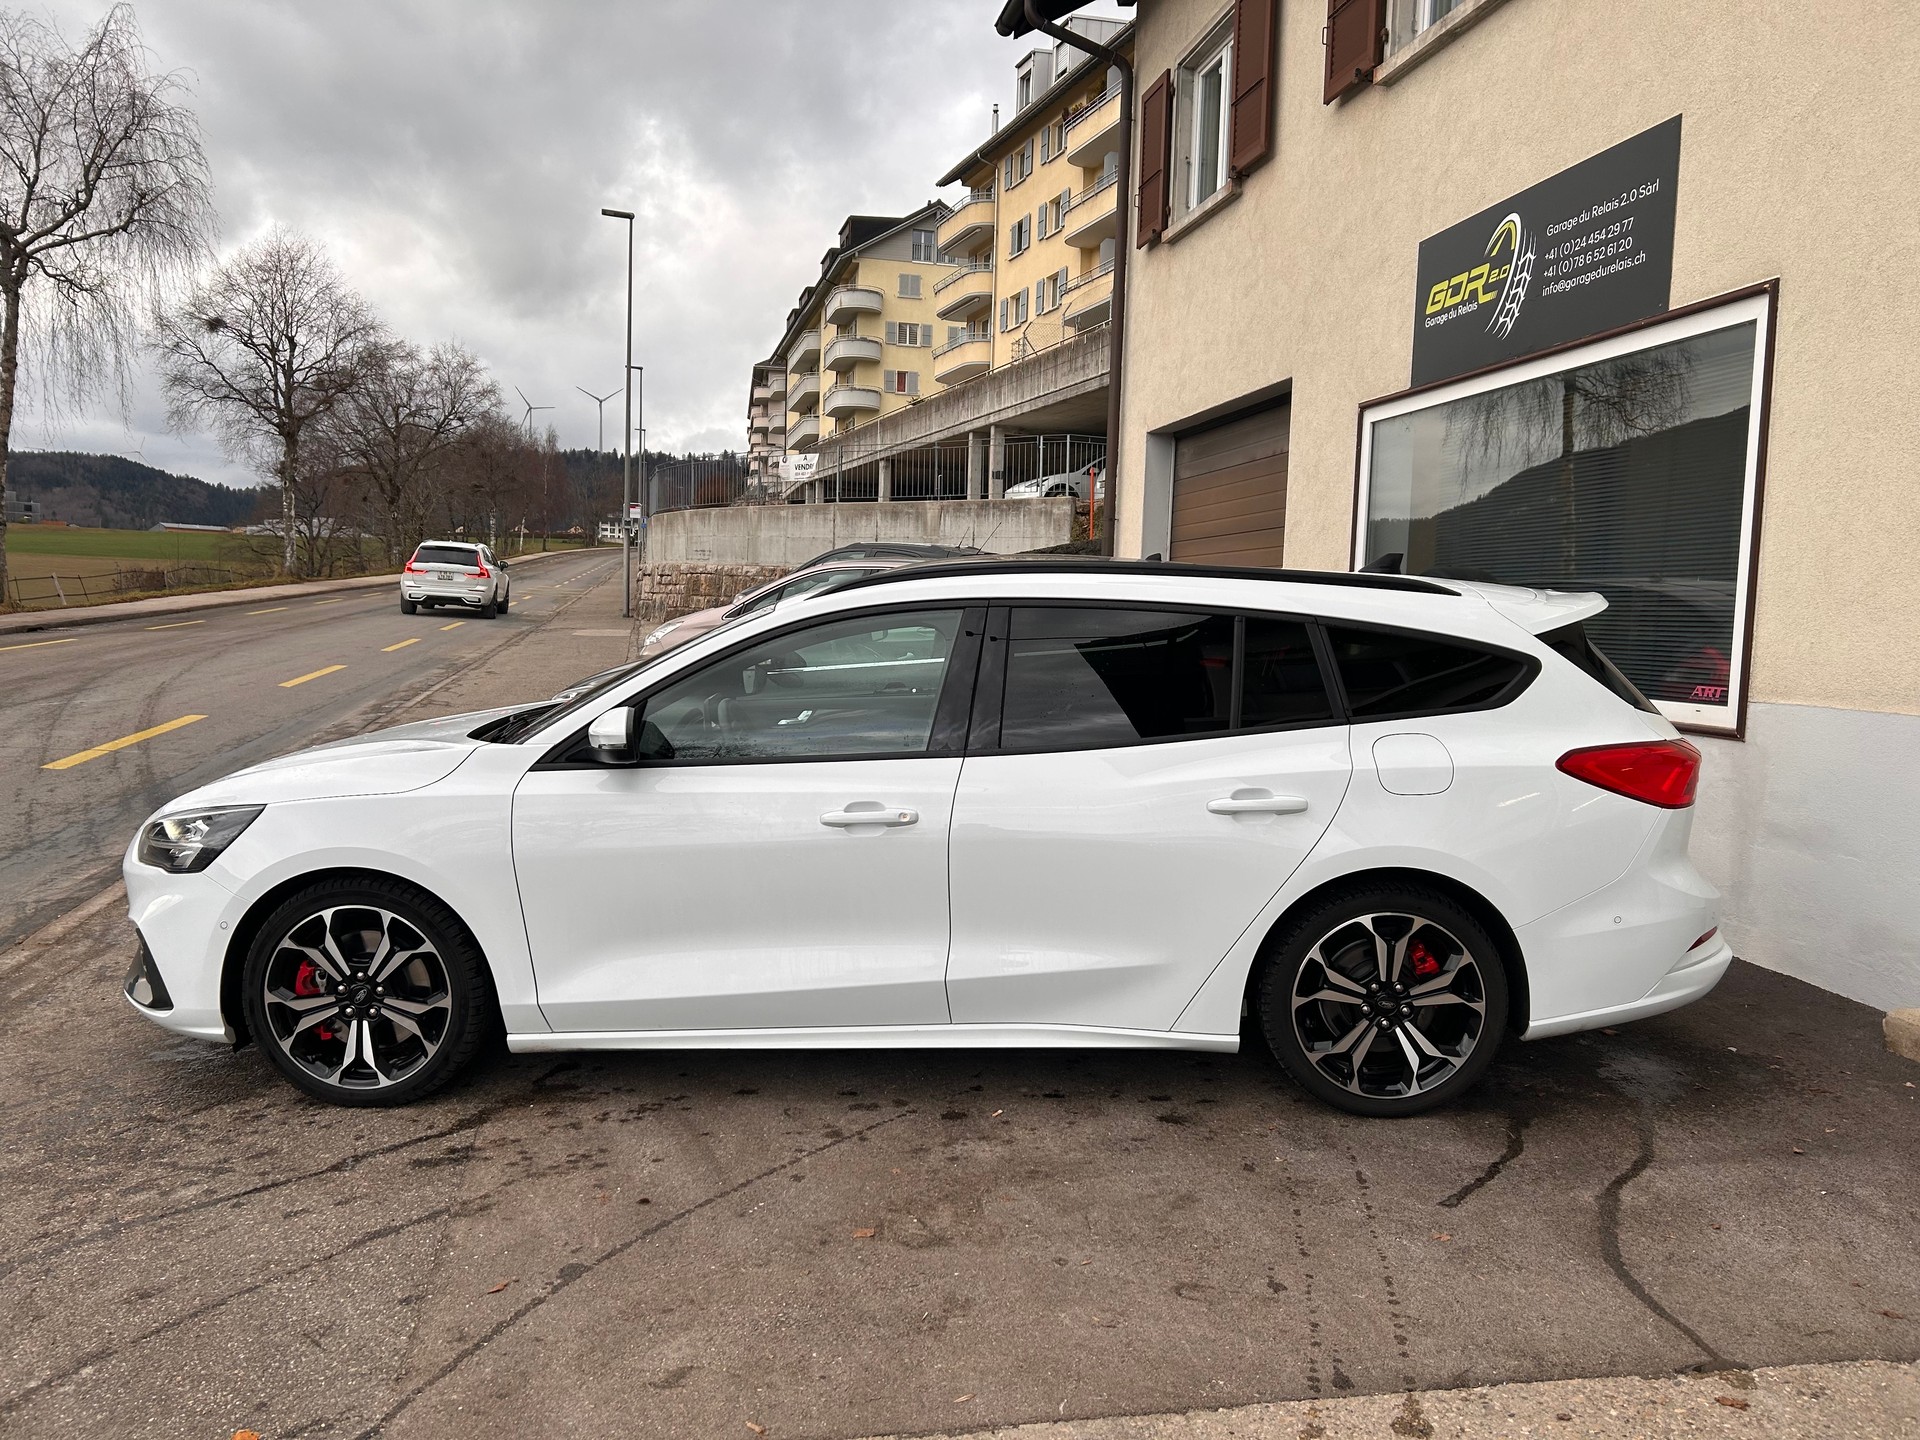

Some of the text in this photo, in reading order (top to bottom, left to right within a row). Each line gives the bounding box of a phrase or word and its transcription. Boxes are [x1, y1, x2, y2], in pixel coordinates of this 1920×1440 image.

[1546, 178, 1660, 237] Garage du Relais 2.0 Sàrl
[1543, 264, 1557, 278] +41
[1593, 246, 1606, 262] 52
[1607, 241, 1618, 256] 61
[1618, 236, 1633, 253] 20
[1544, 246, 1558, 260] +41
[1588, 228, 1606, 245] 454
[1607, 222, 1620, 238] 29
[1622, 216, 1634, 232] 77
[1426, 262, 1511, 315] GDR 2.0
[1542, 250, 1647, 297] info@garagedurelais.ch
[1425, 300, 1478, 328] Garage du Relais
[1691, 686, 1727, 698] ART
